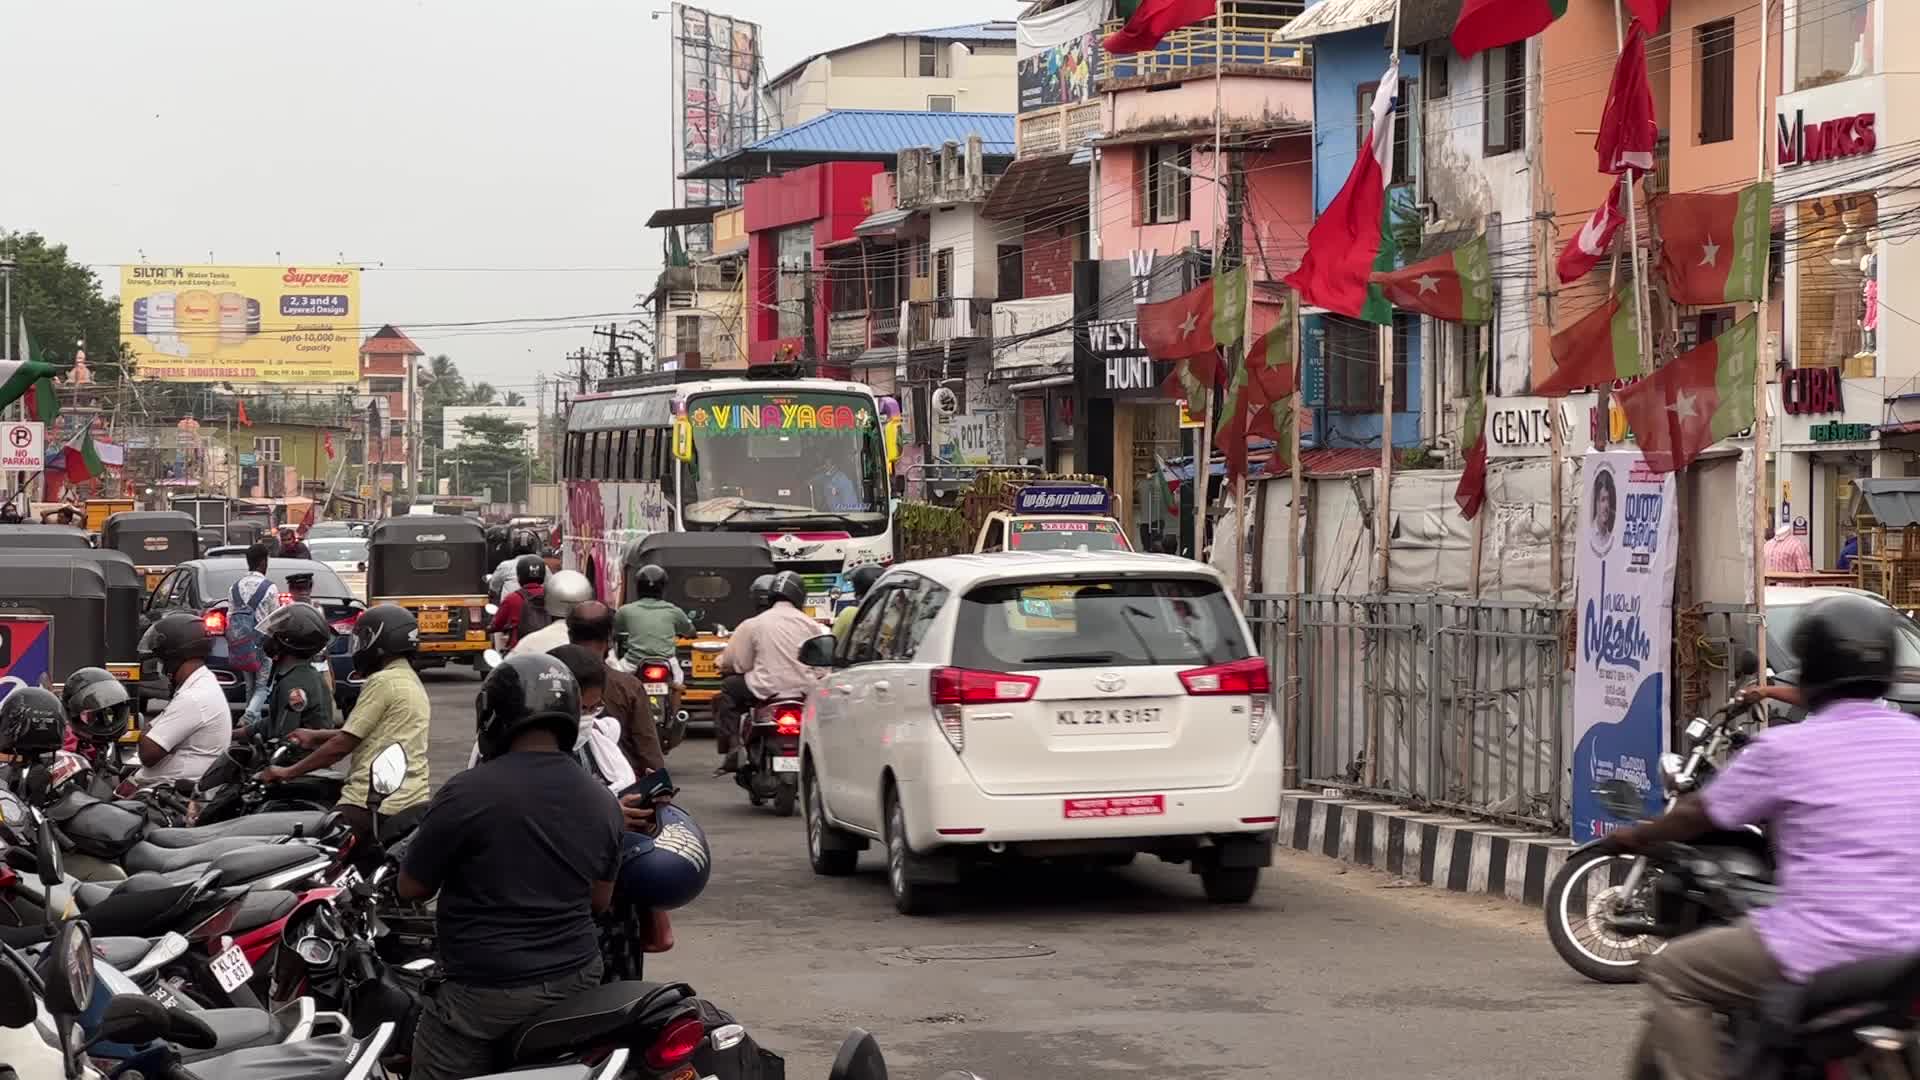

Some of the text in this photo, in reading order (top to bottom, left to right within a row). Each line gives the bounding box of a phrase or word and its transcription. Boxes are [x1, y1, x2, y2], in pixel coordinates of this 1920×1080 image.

[282, 268, 348, 286] Supreme
[290, 296, 338, 306] 2, 3 and 4
[283, 306, 345, 315] Layered Design
[1088, 318, 1146, 351] WEST
[296, 343, 331, 352] Capacity
[188, 368, 239, 377] INDUSTRIES
[1105, 356, 1154, 389] HUNT
[1782, 367, 1845, 416] CUBA
[712, 405, 855, 429] VINAYAGA
[2, 457, 40, 465] PARKING
[1057, 711, 1079, 724] KL
[1083, 710, 1103, 724] 22
[1107, 710, 1120, 724] K
[216, 951, 240, 973] KL 22
